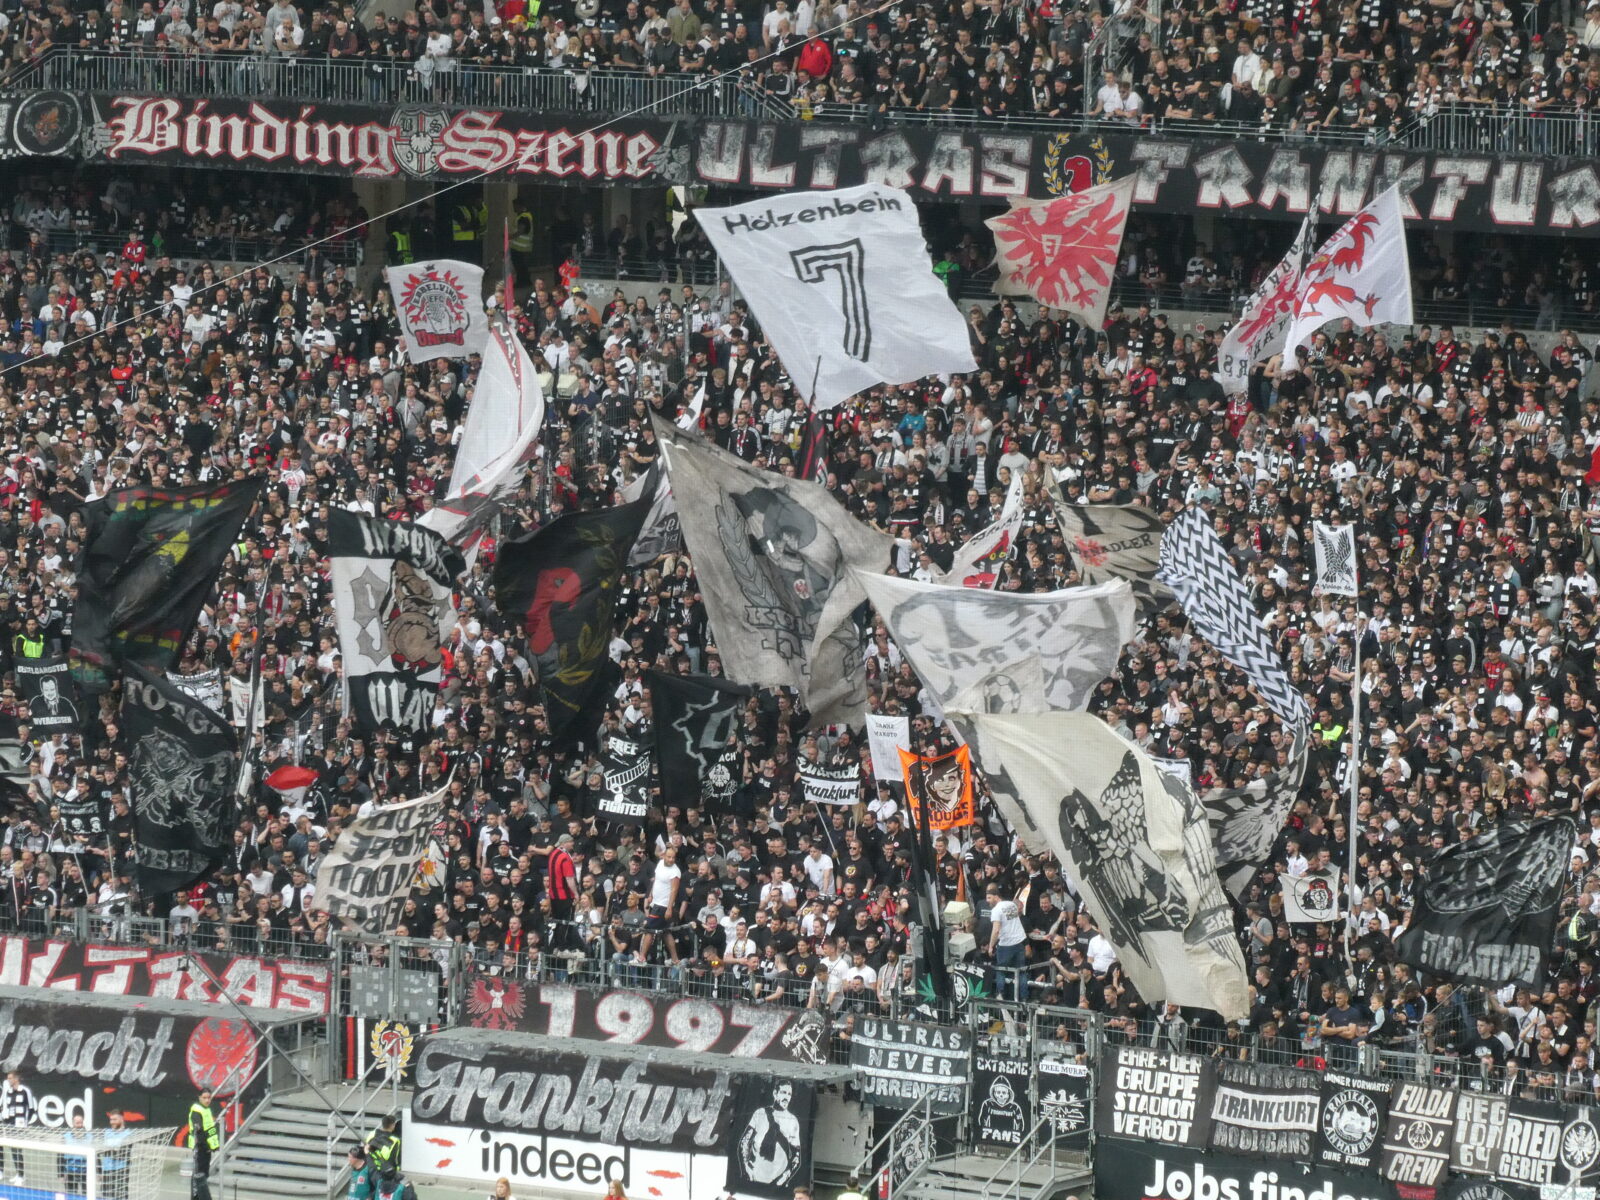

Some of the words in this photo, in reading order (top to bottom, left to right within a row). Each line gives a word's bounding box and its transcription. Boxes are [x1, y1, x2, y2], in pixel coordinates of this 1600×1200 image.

[106, 97, 399, 177] Binding
[439, 111, 656, 184] Szene
[697, 122, 1033, 197] ULTRAS
[722, 192, 902, 235] Hölzenbein
[789, 237, 872, 363] 7
[608, 736, 639, 756] FREE
[797, 755, 860, 780] Eintracht
[801, 780, 861, 801] Frankfurt
[599, 799, 647, 816] FIGHTERS
[539, 985, 794, 1058] 1997
[863, 1020, 962, 1049] ULTRAS
[868, 1048, 952, 1076] NEVER
[977, 1057, 1029, 1075] EXTREME
[1118, 1049, 1157, 1069] EHRE
[1170, 1053, 1202, 1074] DER
[413, 1039, 731, 1147] Frankfurt
[850, 1076, 962, 1103] SURRENDER
[1116, 1067, 1200, 1100] GRUPPE
[1323, 1073, 1351, 1087] IMMER
[1113, 1091, 1196, 1121] STADION
[1218, 1093, 1318, 1125] FRANKFURT
[1328, 1090, 1378, 1116] RADIKALE
[1394, 1084, 1454, 1118] FULDA
[1456, 1095, 1507, 1126] REG
[981, 1128, 1021, 1143] FANS
[1113, 1111, 1193, 1144] VERBOT
[1213, 1122, 1310, 1156] HOOLIGANS
[1394, 1124, 1406, 1141] 3
[1432, 1130, 1445, 1148] 6
[1455, 1120, 1504, 1149] ION
[1502, 1117, 1562, 1160] RIED
[481, 1128, 631, 1188] indeed
[1322, 1150, 1342, 1162] OHNE
[1345, 1155, 1371, 1167] FURCHT
[1387, 1153, 1445, 1186] CREW
[1459, 1143, 1492, 1170] 64
[1498, 1153, 1556, 1185] GEBIET
[1145, 1160, 1239, 1200] Jobs
